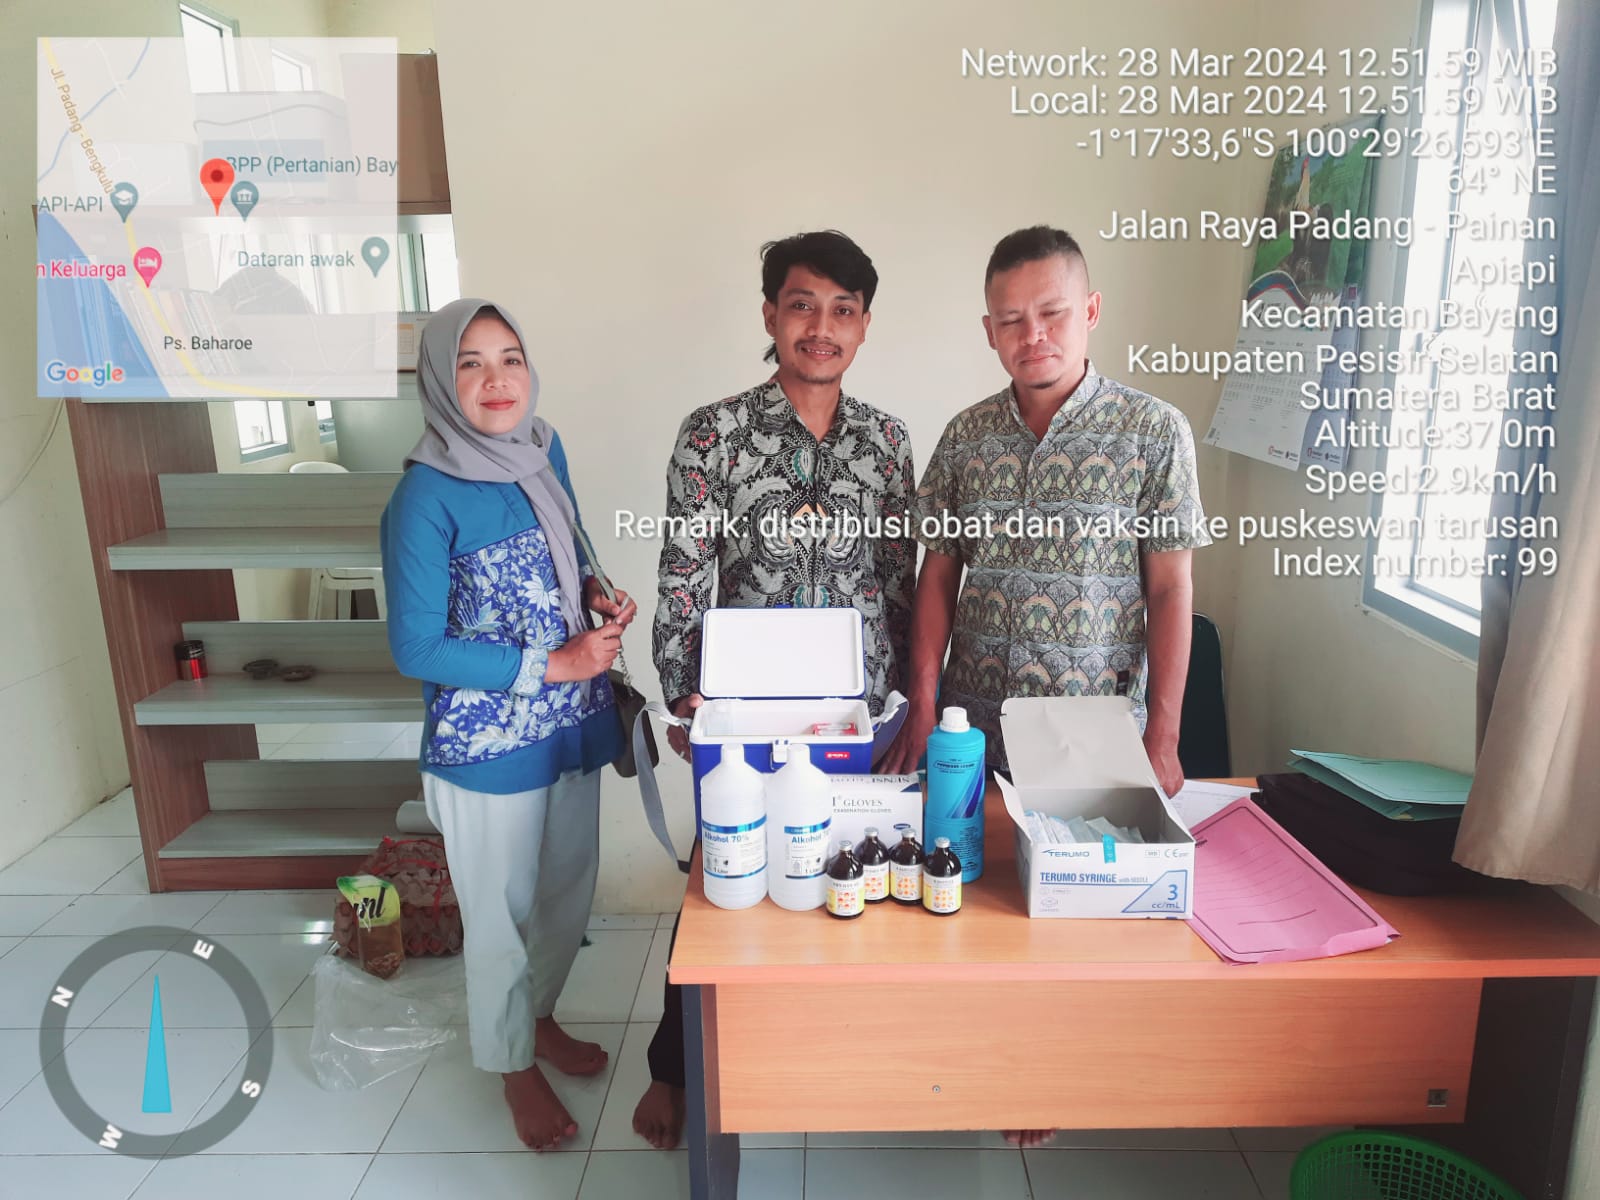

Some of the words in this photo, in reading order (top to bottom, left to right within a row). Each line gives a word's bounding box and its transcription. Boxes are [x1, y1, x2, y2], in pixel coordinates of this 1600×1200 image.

[844, 798, 883, 807] GLOVES
[703, 830, 729, 844] Alkohol
[791, 834, 823, 845] Alkohol
[1047, 849, 1090, 858] TERUMO
[1040, 872, 1077, 883] TERUMO
[1079, 873, 1117, 883] SYRINGE
[1167, 884, 1178, 901] 3
[1151, 901, 1181, 910] cc/mL
